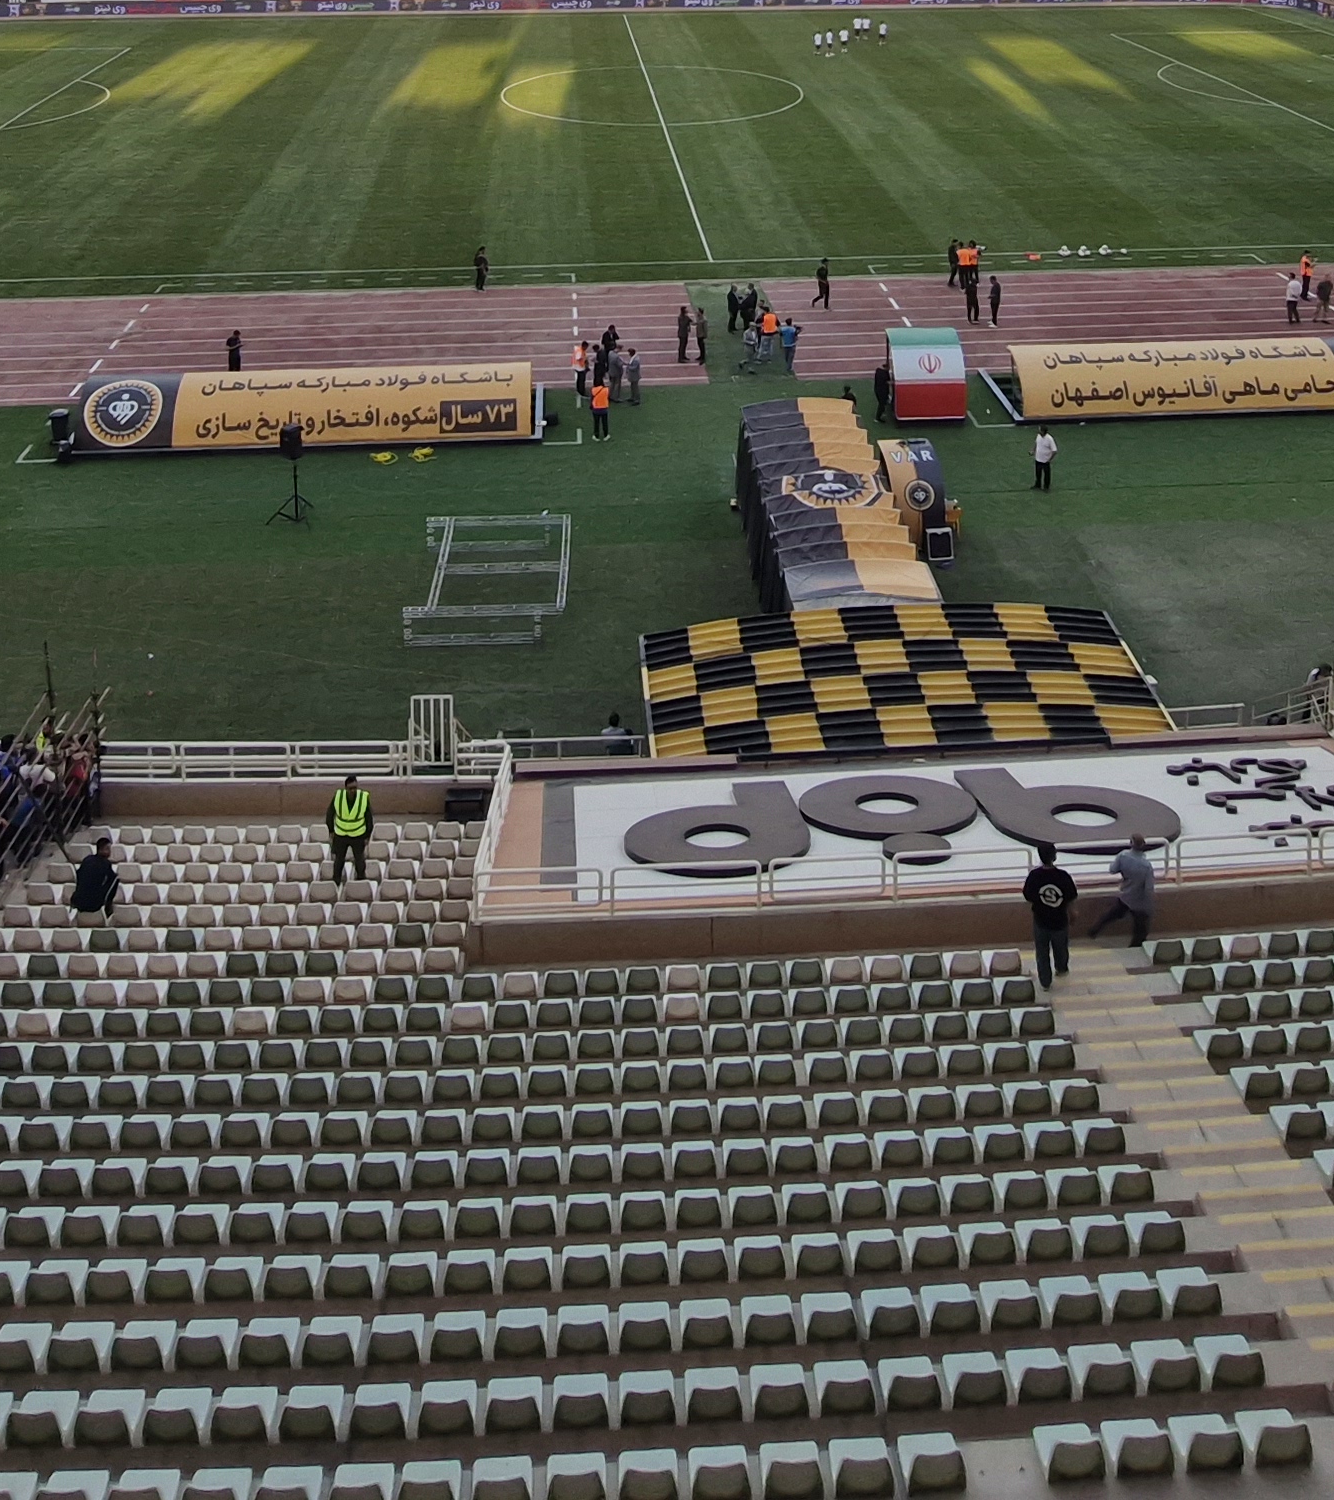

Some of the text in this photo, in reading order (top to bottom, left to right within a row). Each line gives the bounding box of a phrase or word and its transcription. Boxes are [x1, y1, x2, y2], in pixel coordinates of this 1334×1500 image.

[1043, 345, 1326, 372] باشگاه فولاد مبارکه سپاهان
[201, 370, 513, 398] باشگاه فولاد مبارکه سپاهان
[1050, 381, 1129, 408] اصفهان
[1132, 375, 1220, 407] آفانیوس
[1221, 380, 1280, 403] ماهی
[195, 408, 252, 439] سازی
[317, 407, 381, 434] افتخار
[383, 405, 438, 429] شکوه،
[441, 402, 484, 432] سال
[487, 404, 515, 423] ۷۳
[890, 449, 935, 463] VAR
